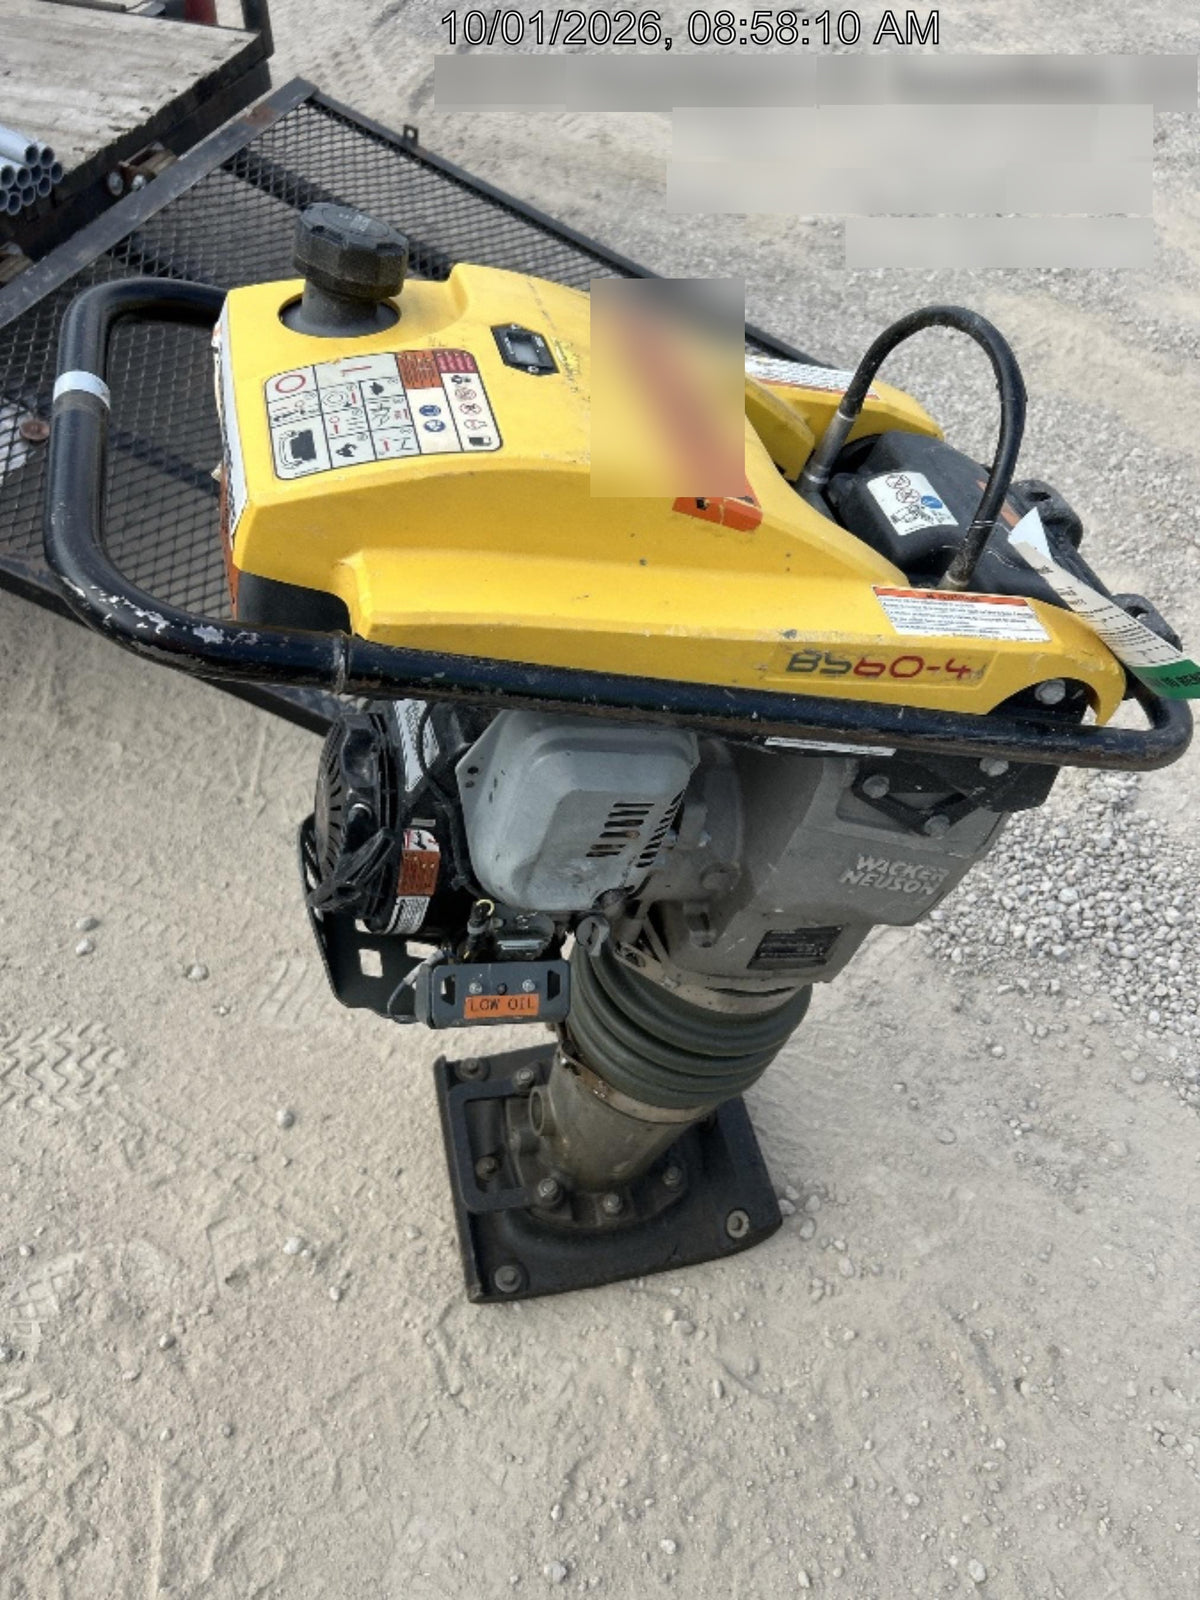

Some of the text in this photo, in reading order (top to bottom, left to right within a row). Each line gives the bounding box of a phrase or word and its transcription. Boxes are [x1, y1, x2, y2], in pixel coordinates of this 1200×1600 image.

[786, 650, 971, 679] BS60-4
[857, 855, 949, 882] WACKER
[840, 869, 940, 895] NEUSON
[469, 997, 536, 1012] LOW OIL
